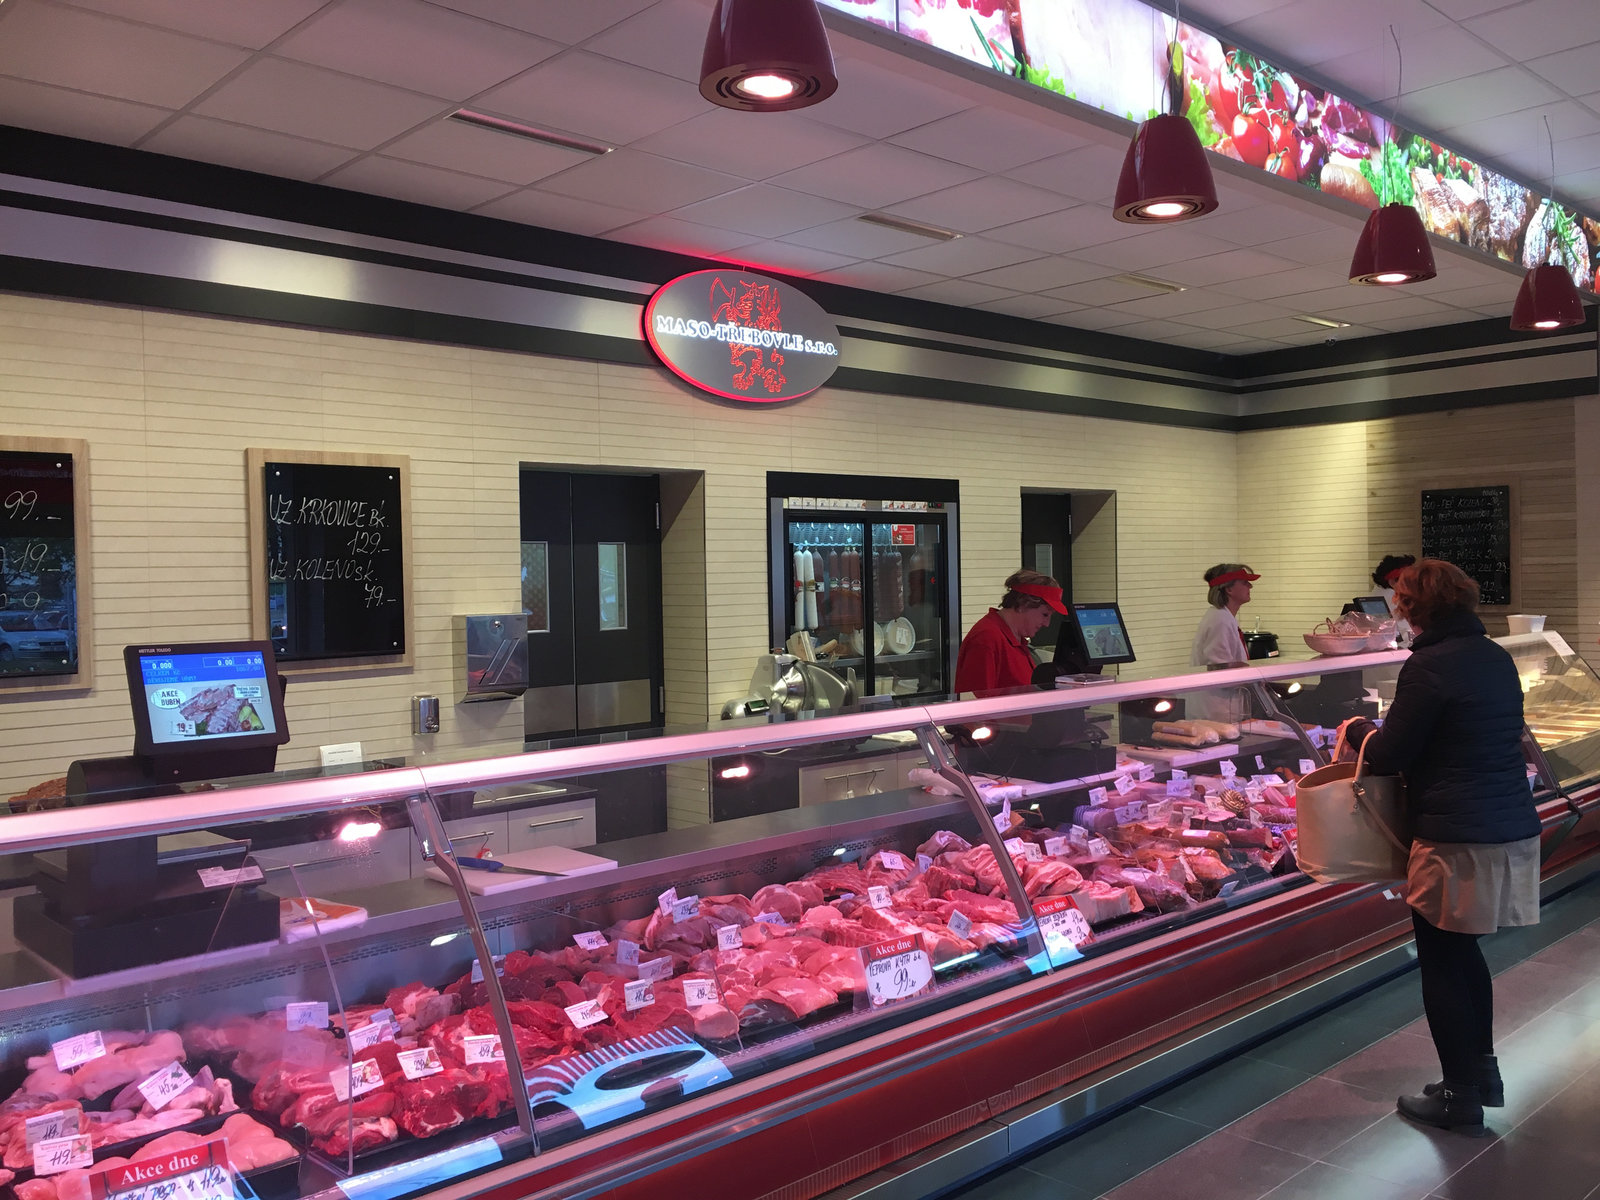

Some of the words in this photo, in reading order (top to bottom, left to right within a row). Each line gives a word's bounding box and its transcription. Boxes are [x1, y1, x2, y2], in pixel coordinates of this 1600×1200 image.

[804, 339, 839, 356] s.r.o.
[875, 945, 896, 957] Akce
[896, 940, 912, 951] dne
[121, 1163, 164, 1185] Akce
[168, 1152, 199, 1171] dne
